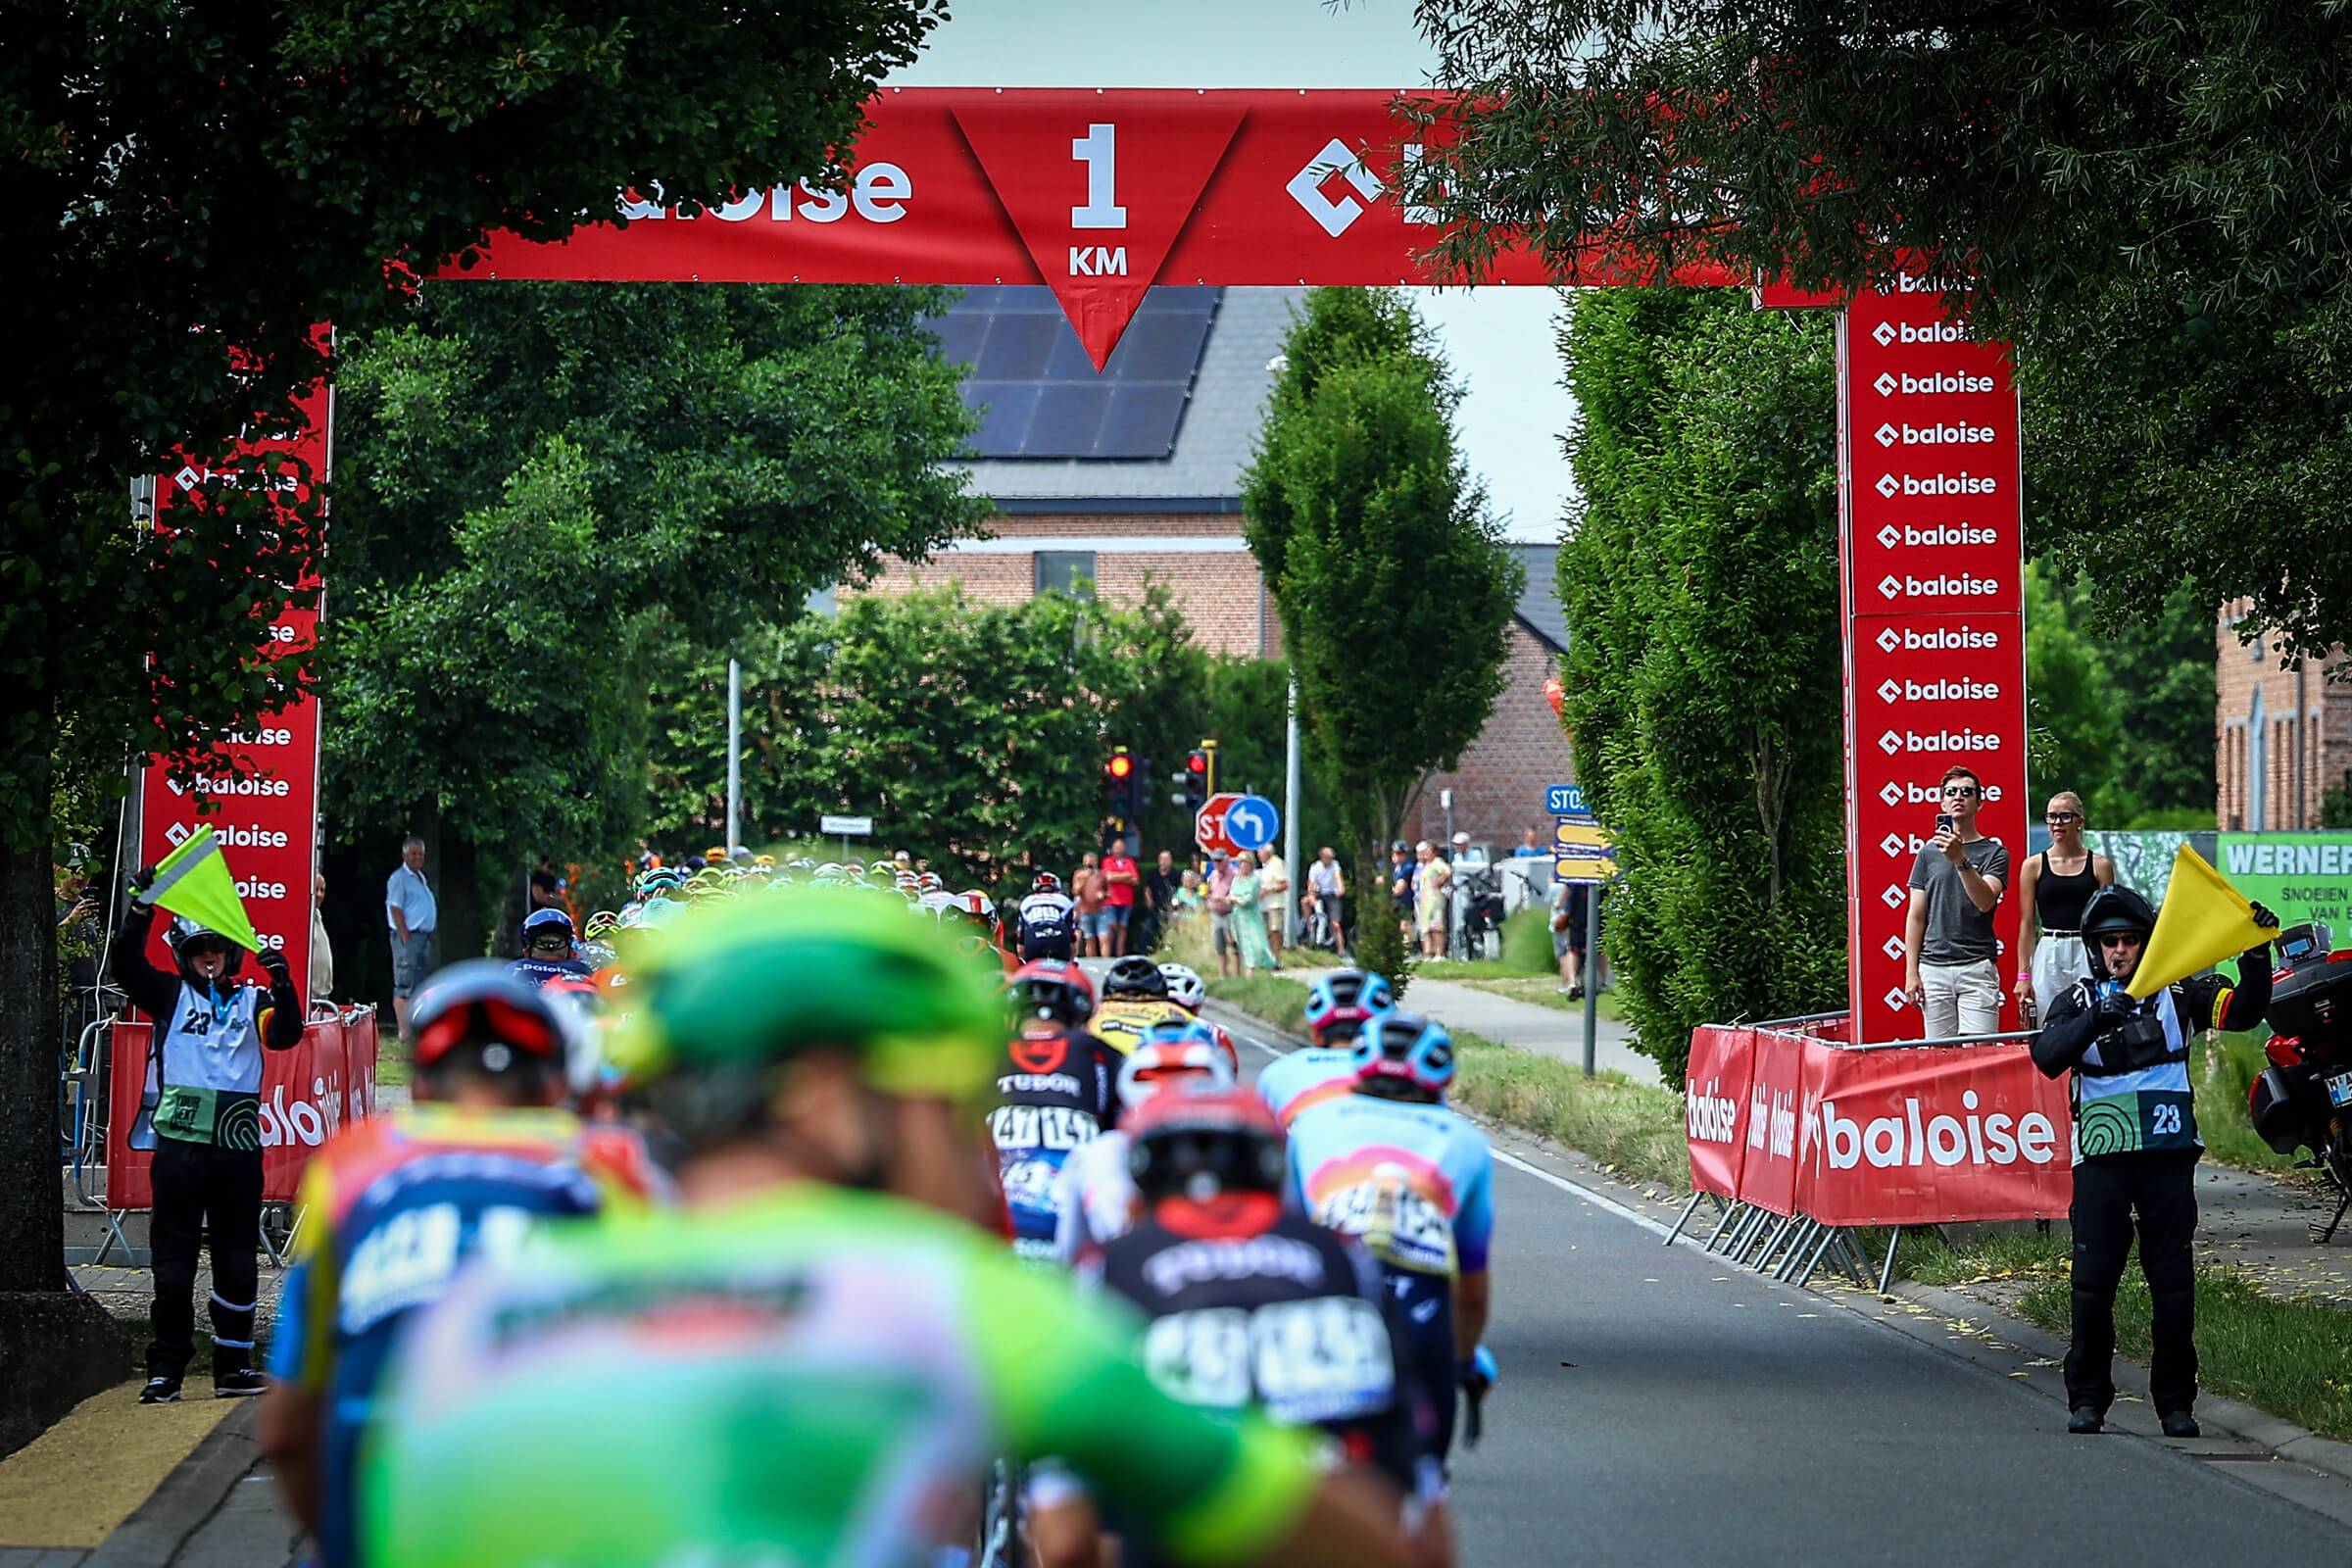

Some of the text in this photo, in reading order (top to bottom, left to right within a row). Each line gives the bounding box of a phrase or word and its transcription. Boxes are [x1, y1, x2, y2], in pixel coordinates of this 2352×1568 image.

[1071, 123, 1127, 229] 1
[1068, 246, 1128, 276] KM
[1901, 370, 1994, 394] baloise
[1902, 420, 1995, 445] baloise
[1903, 471, 1996, 495] baloise
[1904, 521, 1997, 546] baloise
[1905, 572, 1999, 597] baloise
[1904, 625, 1998, 650] baloise
[1905, 676, 2000, 701] baloise
[1906, 727, 2001, 753] baloise
[196, 772, 290, 797] baloise
[193, 823, 288, 848] aloise
[1200, 814, 1227, 841] ST
[2280, 886, 2349, 902] SNOEIEN
[2308, 906, 2340, 921] VAN
[181, 1008, 213, 1037] 23
[1687, 1075, 1736, 1145] baloise
[2152, 1103, 2182, 1135] 23
[1822, 1089, 2057, 1171] baloise
